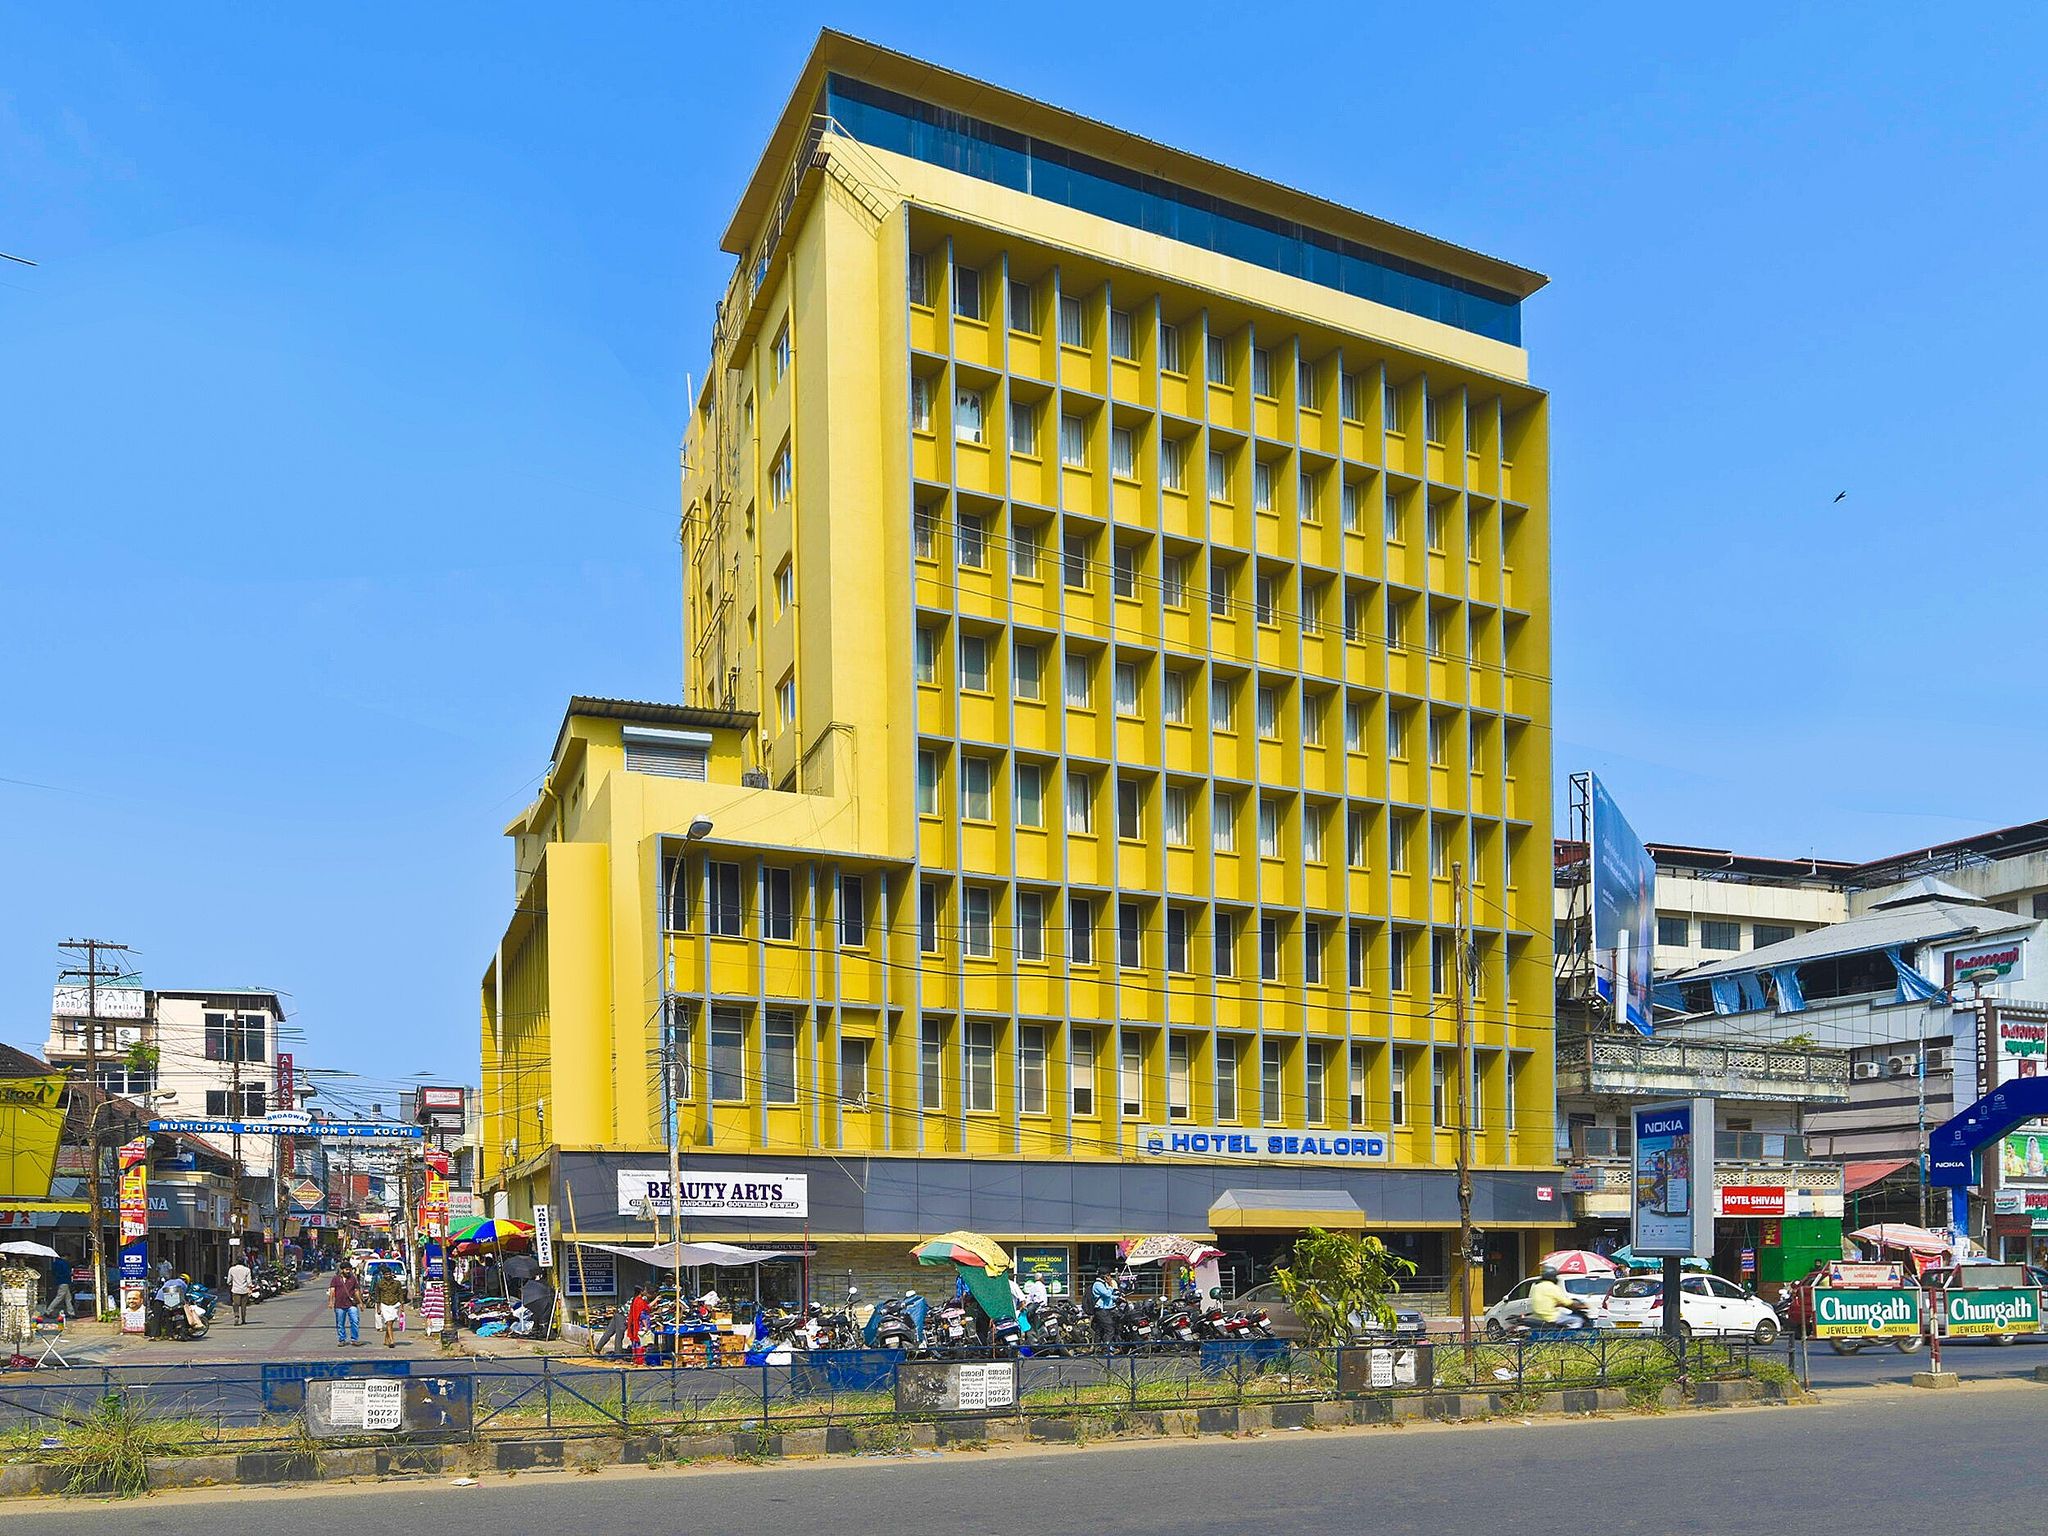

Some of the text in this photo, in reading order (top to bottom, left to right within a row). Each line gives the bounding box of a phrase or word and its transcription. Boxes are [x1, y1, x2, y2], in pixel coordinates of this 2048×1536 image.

[267, 1112, 309, 1122] BROADWAY
[159, 1121, 234, 1132] MUNICIPAL
[243, 1125, 338, 1135] CORPORATION
[373, 1127, 413, 1136] KOCHI
[1644, 1119, 1684, 1134] NOKIA
[1171, 1132, 1383, 1157] HOTEL SEALORD
[646, 1181, 783, 1201] BEAUTY ARTS
[1724, 1195, 1783, 1205] HOTEL SHIVAM
[537, 1208, 549, 1261] HANDICRAFTS
[1820, 1297, 1911, 1331] Chungath
[1950, 1296, 2032, 1329] Chungath
[1826, 1326, 1868, 1335] JEWELLERY
[1956, 1326, 1994, 1334] JEWELLERY
[368, 1409, 399, 1417] 90727
[368, 1417, 399, 1425] 99090
